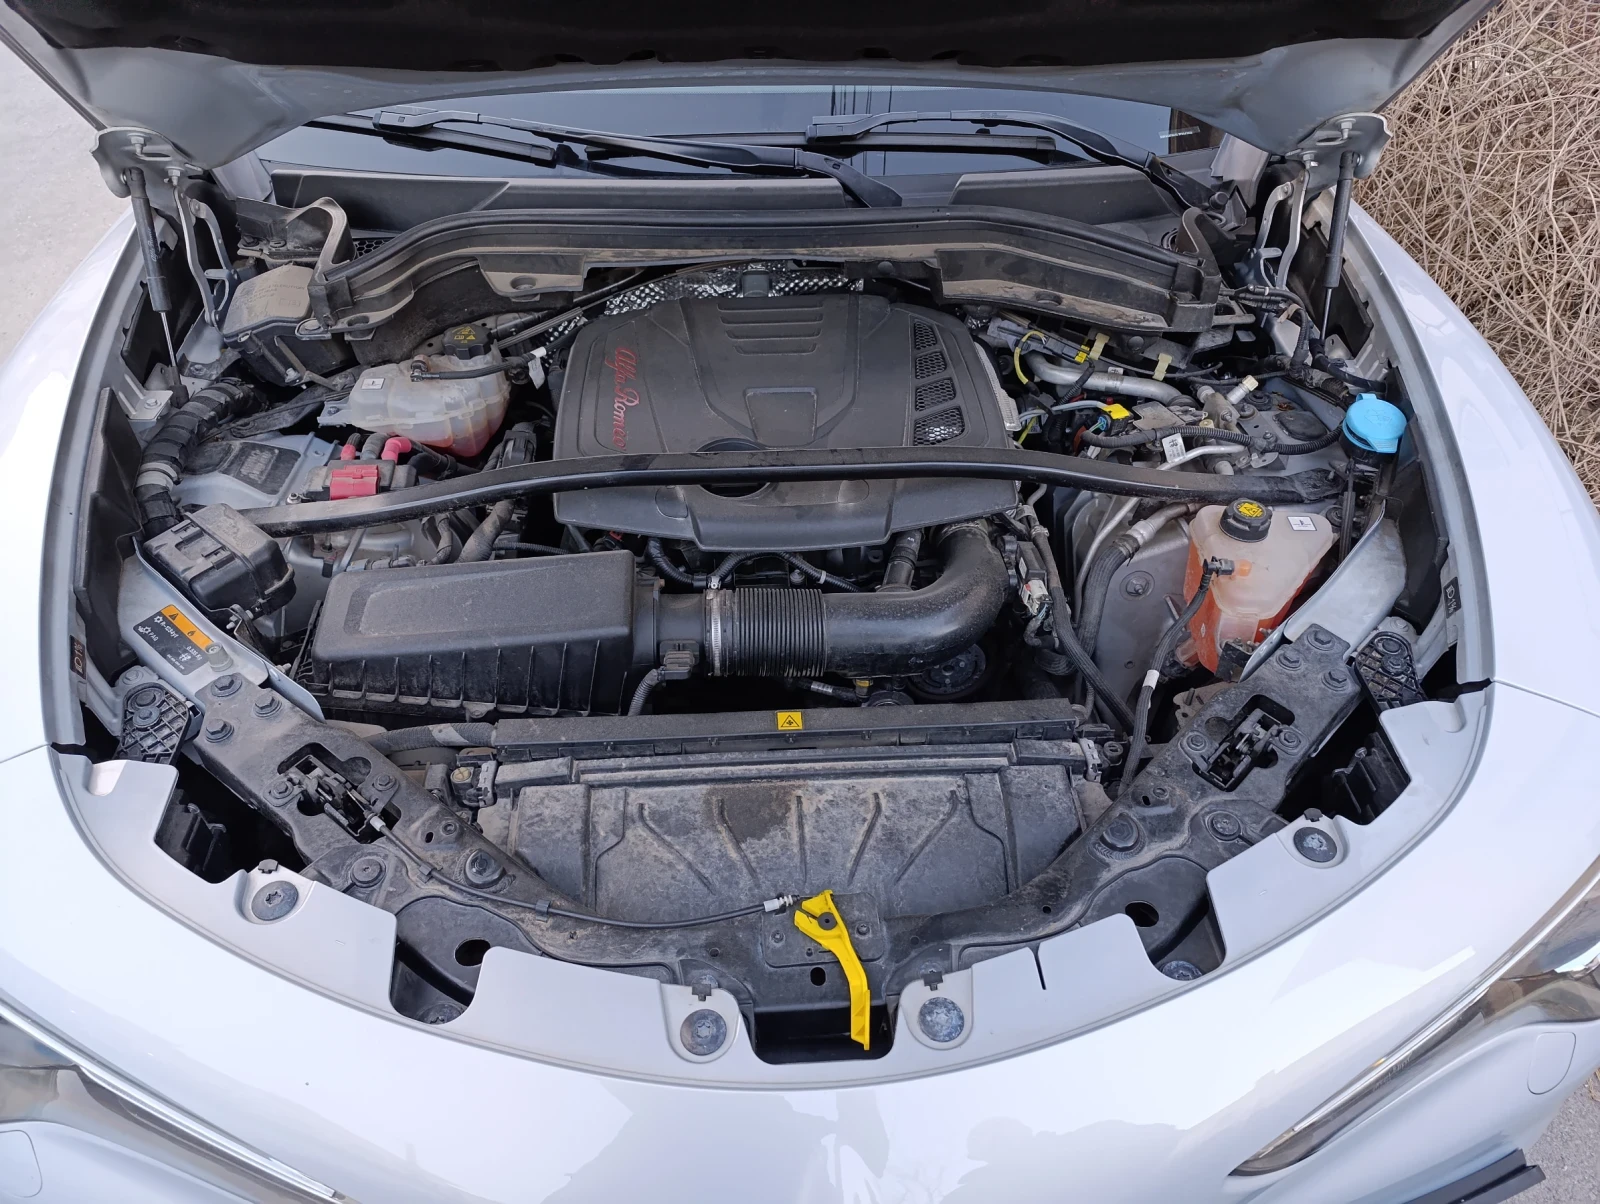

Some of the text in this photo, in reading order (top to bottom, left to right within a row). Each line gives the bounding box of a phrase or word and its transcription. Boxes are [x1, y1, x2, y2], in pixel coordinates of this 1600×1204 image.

[605, 347, 640, 451] Alfa Romeo
[148, 632, 159, 642] PAG
